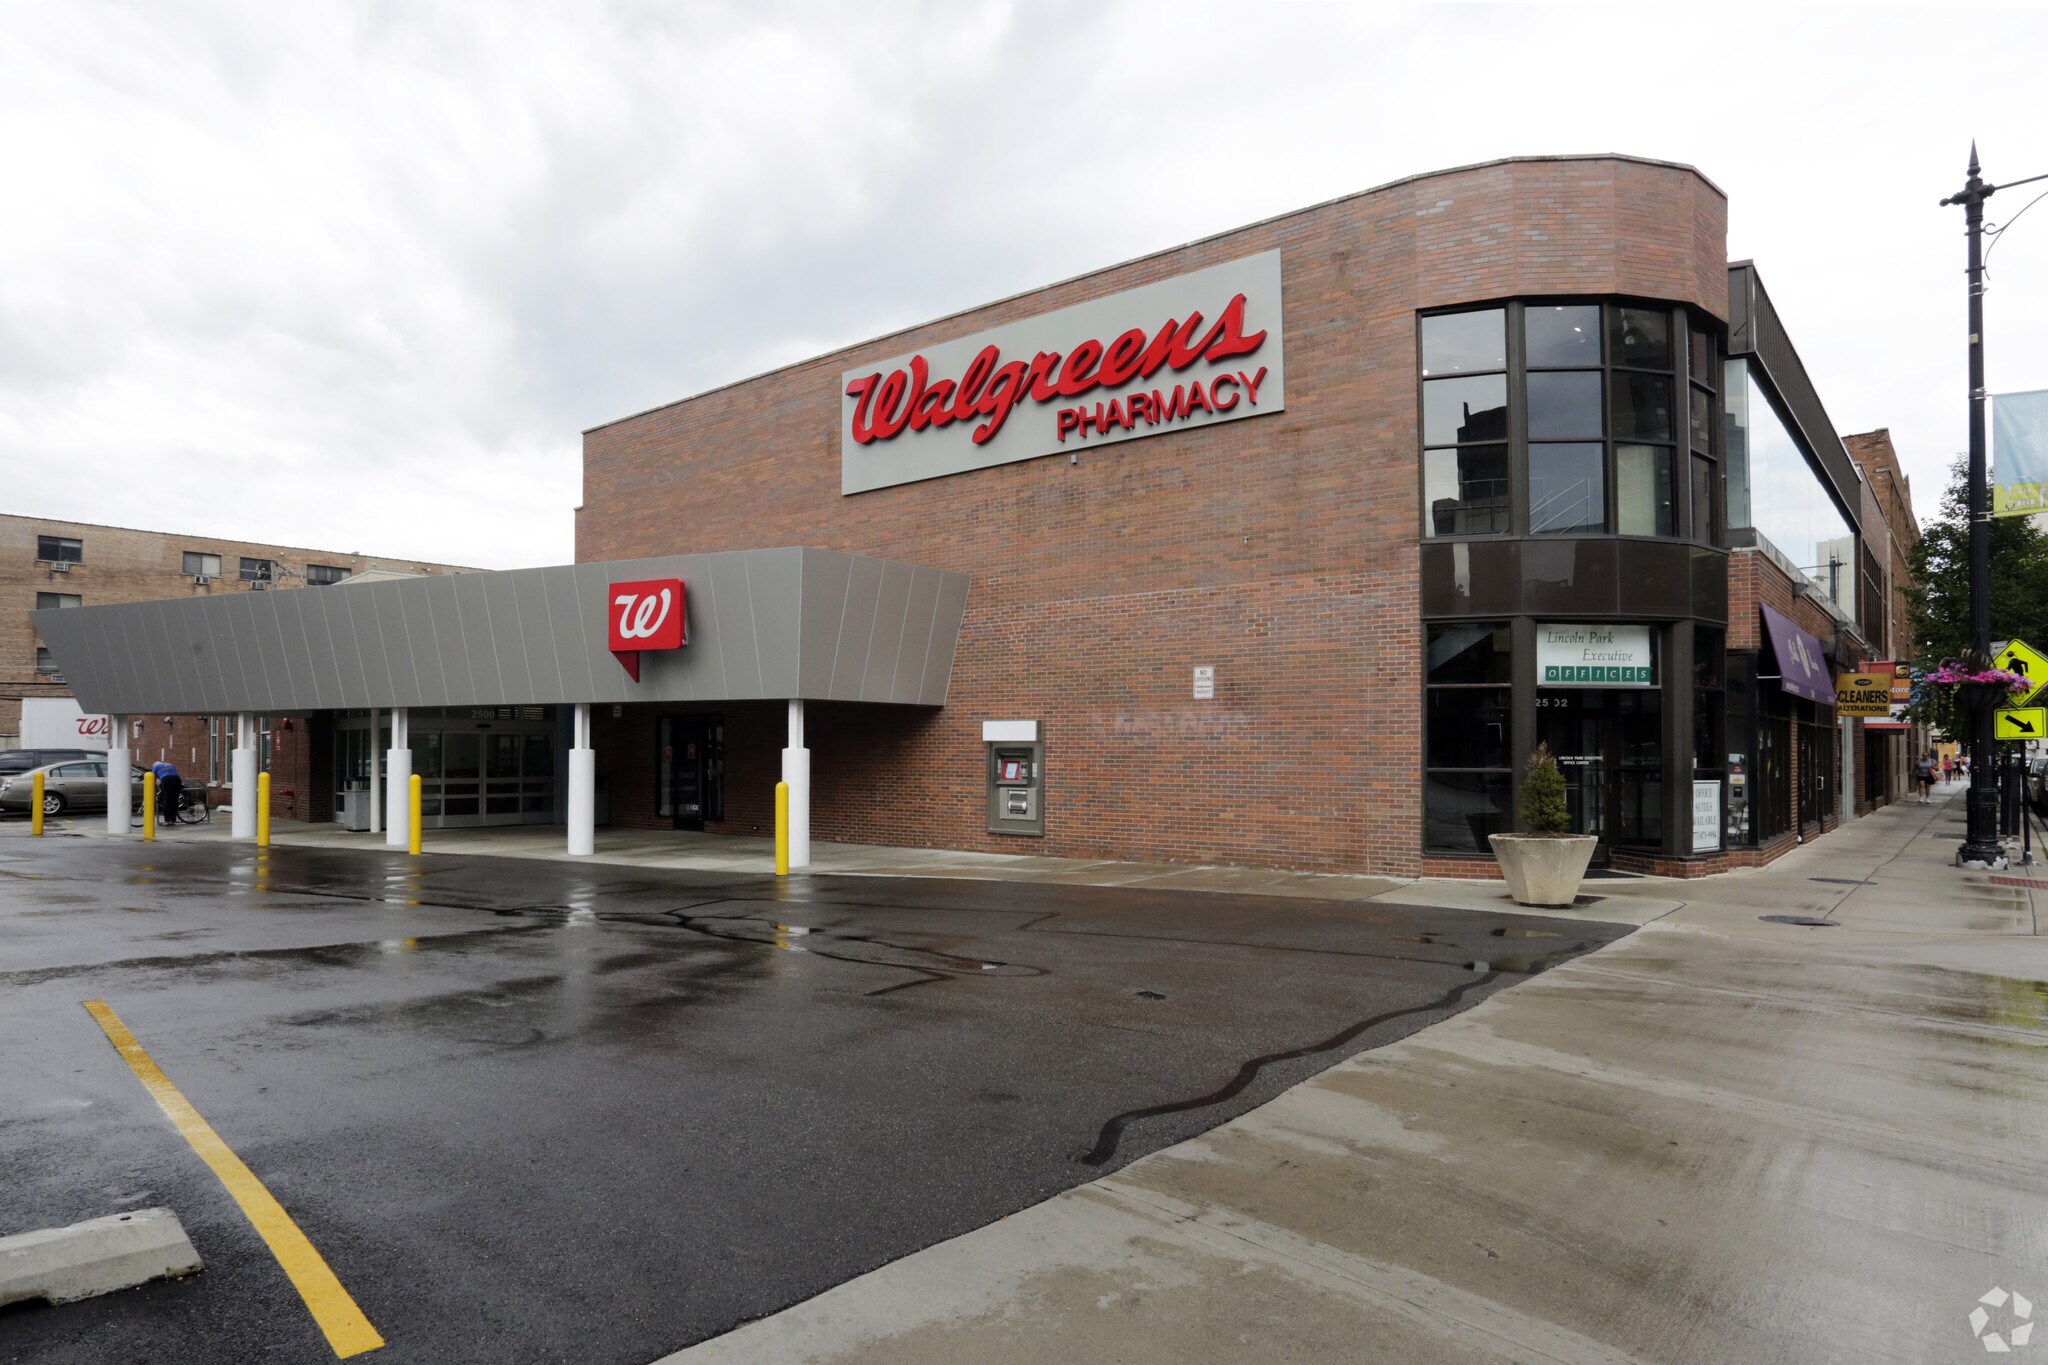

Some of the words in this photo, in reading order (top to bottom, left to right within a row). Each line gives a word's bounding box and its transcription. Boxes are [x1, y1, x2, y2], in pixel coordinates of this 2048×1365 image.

[845, 293, 1267, 445] Walgreens
[1057, 366, 1268, 443] PHARMACY
[614, 588, 672, 639] W
[1547, 631, 1585, 644] Lincoln
[1588, 631, 1615, 644] Park
[1582, 648, 1633, 661] Executive
[1548, 669, 1648, 679] OFFICES
[1838, 690, 1888, 703] CLEANERS
[471, 709, 495, 719] 2500
[1695, 788, 1712, 798] OFFICE
[1695, 802, 1712, 812] SUITES
[1693, 815, 1717, 826] VAILABLE
